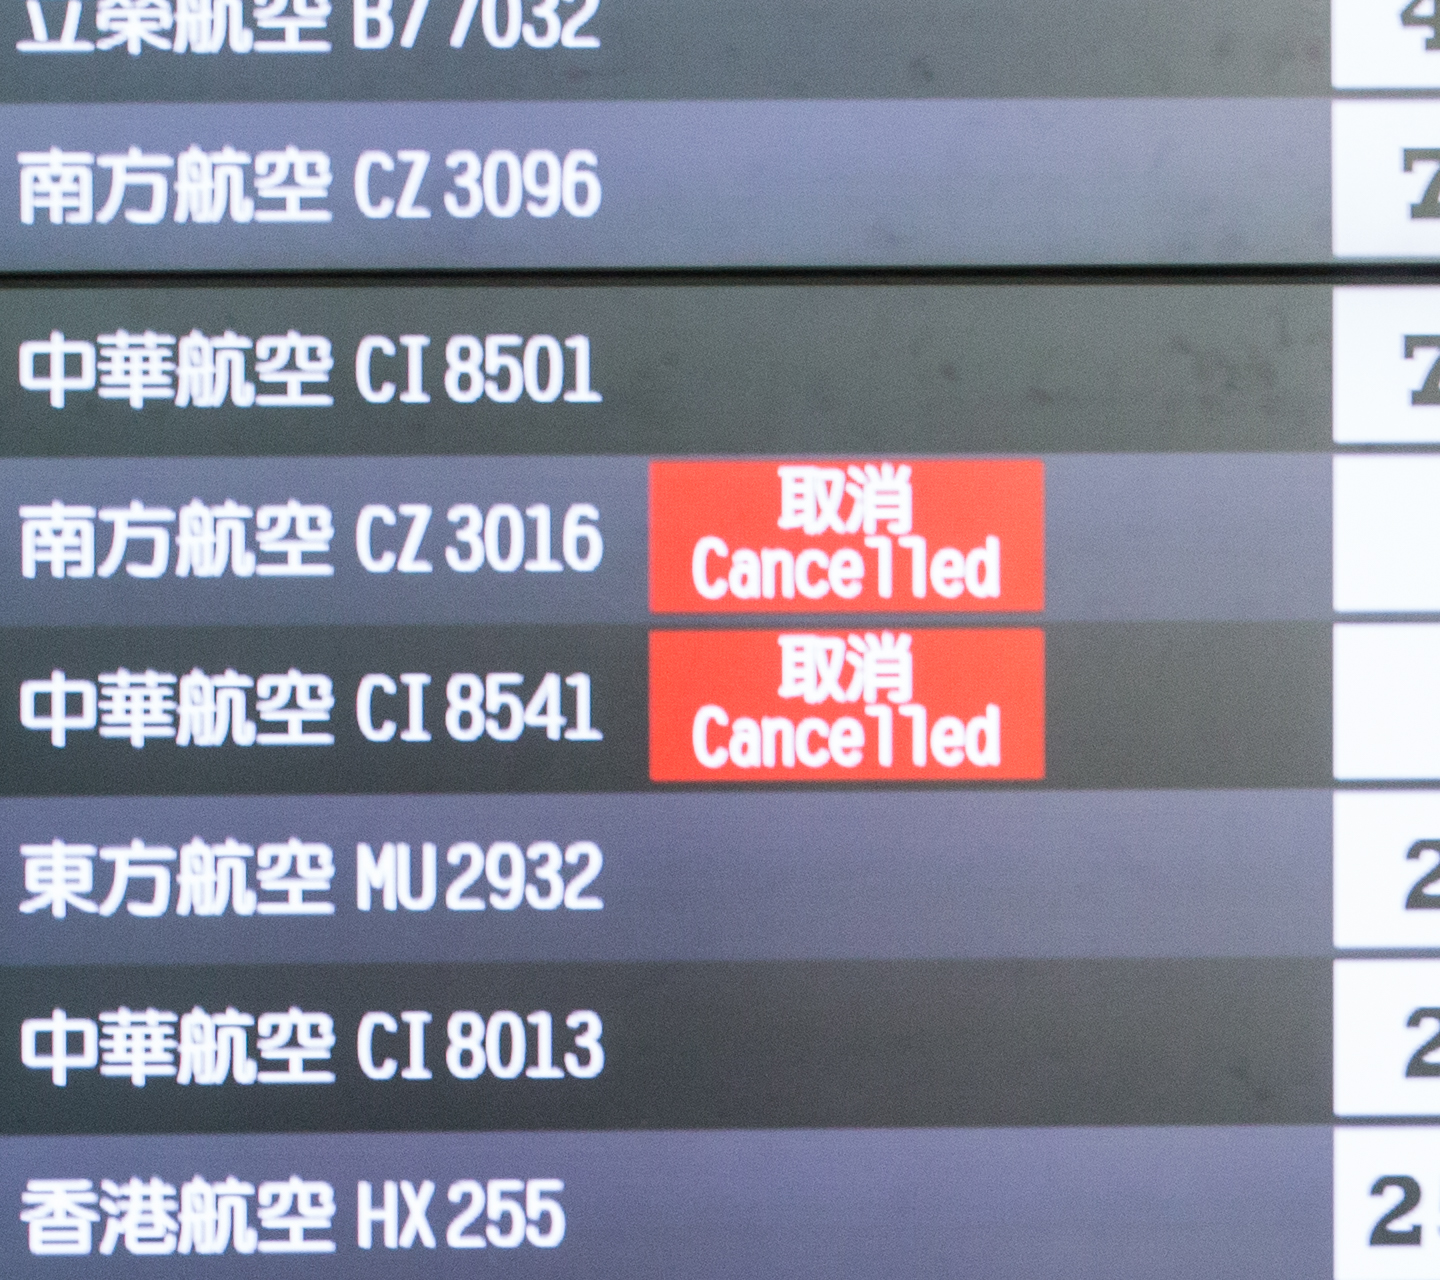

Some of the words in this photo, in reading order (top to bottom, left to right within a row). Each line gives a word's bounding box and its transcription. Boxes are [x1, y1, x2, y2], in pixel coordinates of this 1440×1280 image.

[16, 144, 334, 226] 南方航空
[18, 329, 335, 410] 中華航空
[18, 497, 336, 580] 南方航空
[776, 460, 915, 537] 取消
[690, 533, 1003, 602] Cancelled
[776, 628, 915, 706] 取消
[19, 668, 336, 749] 中華航空
[690, 702, 1003, 770] Cancelled
[18, 836, 336, 920] 東方航空
[20, 1006, 336, 1087] 中華航空
[19, 1174, 337, 1256] 香港航空
